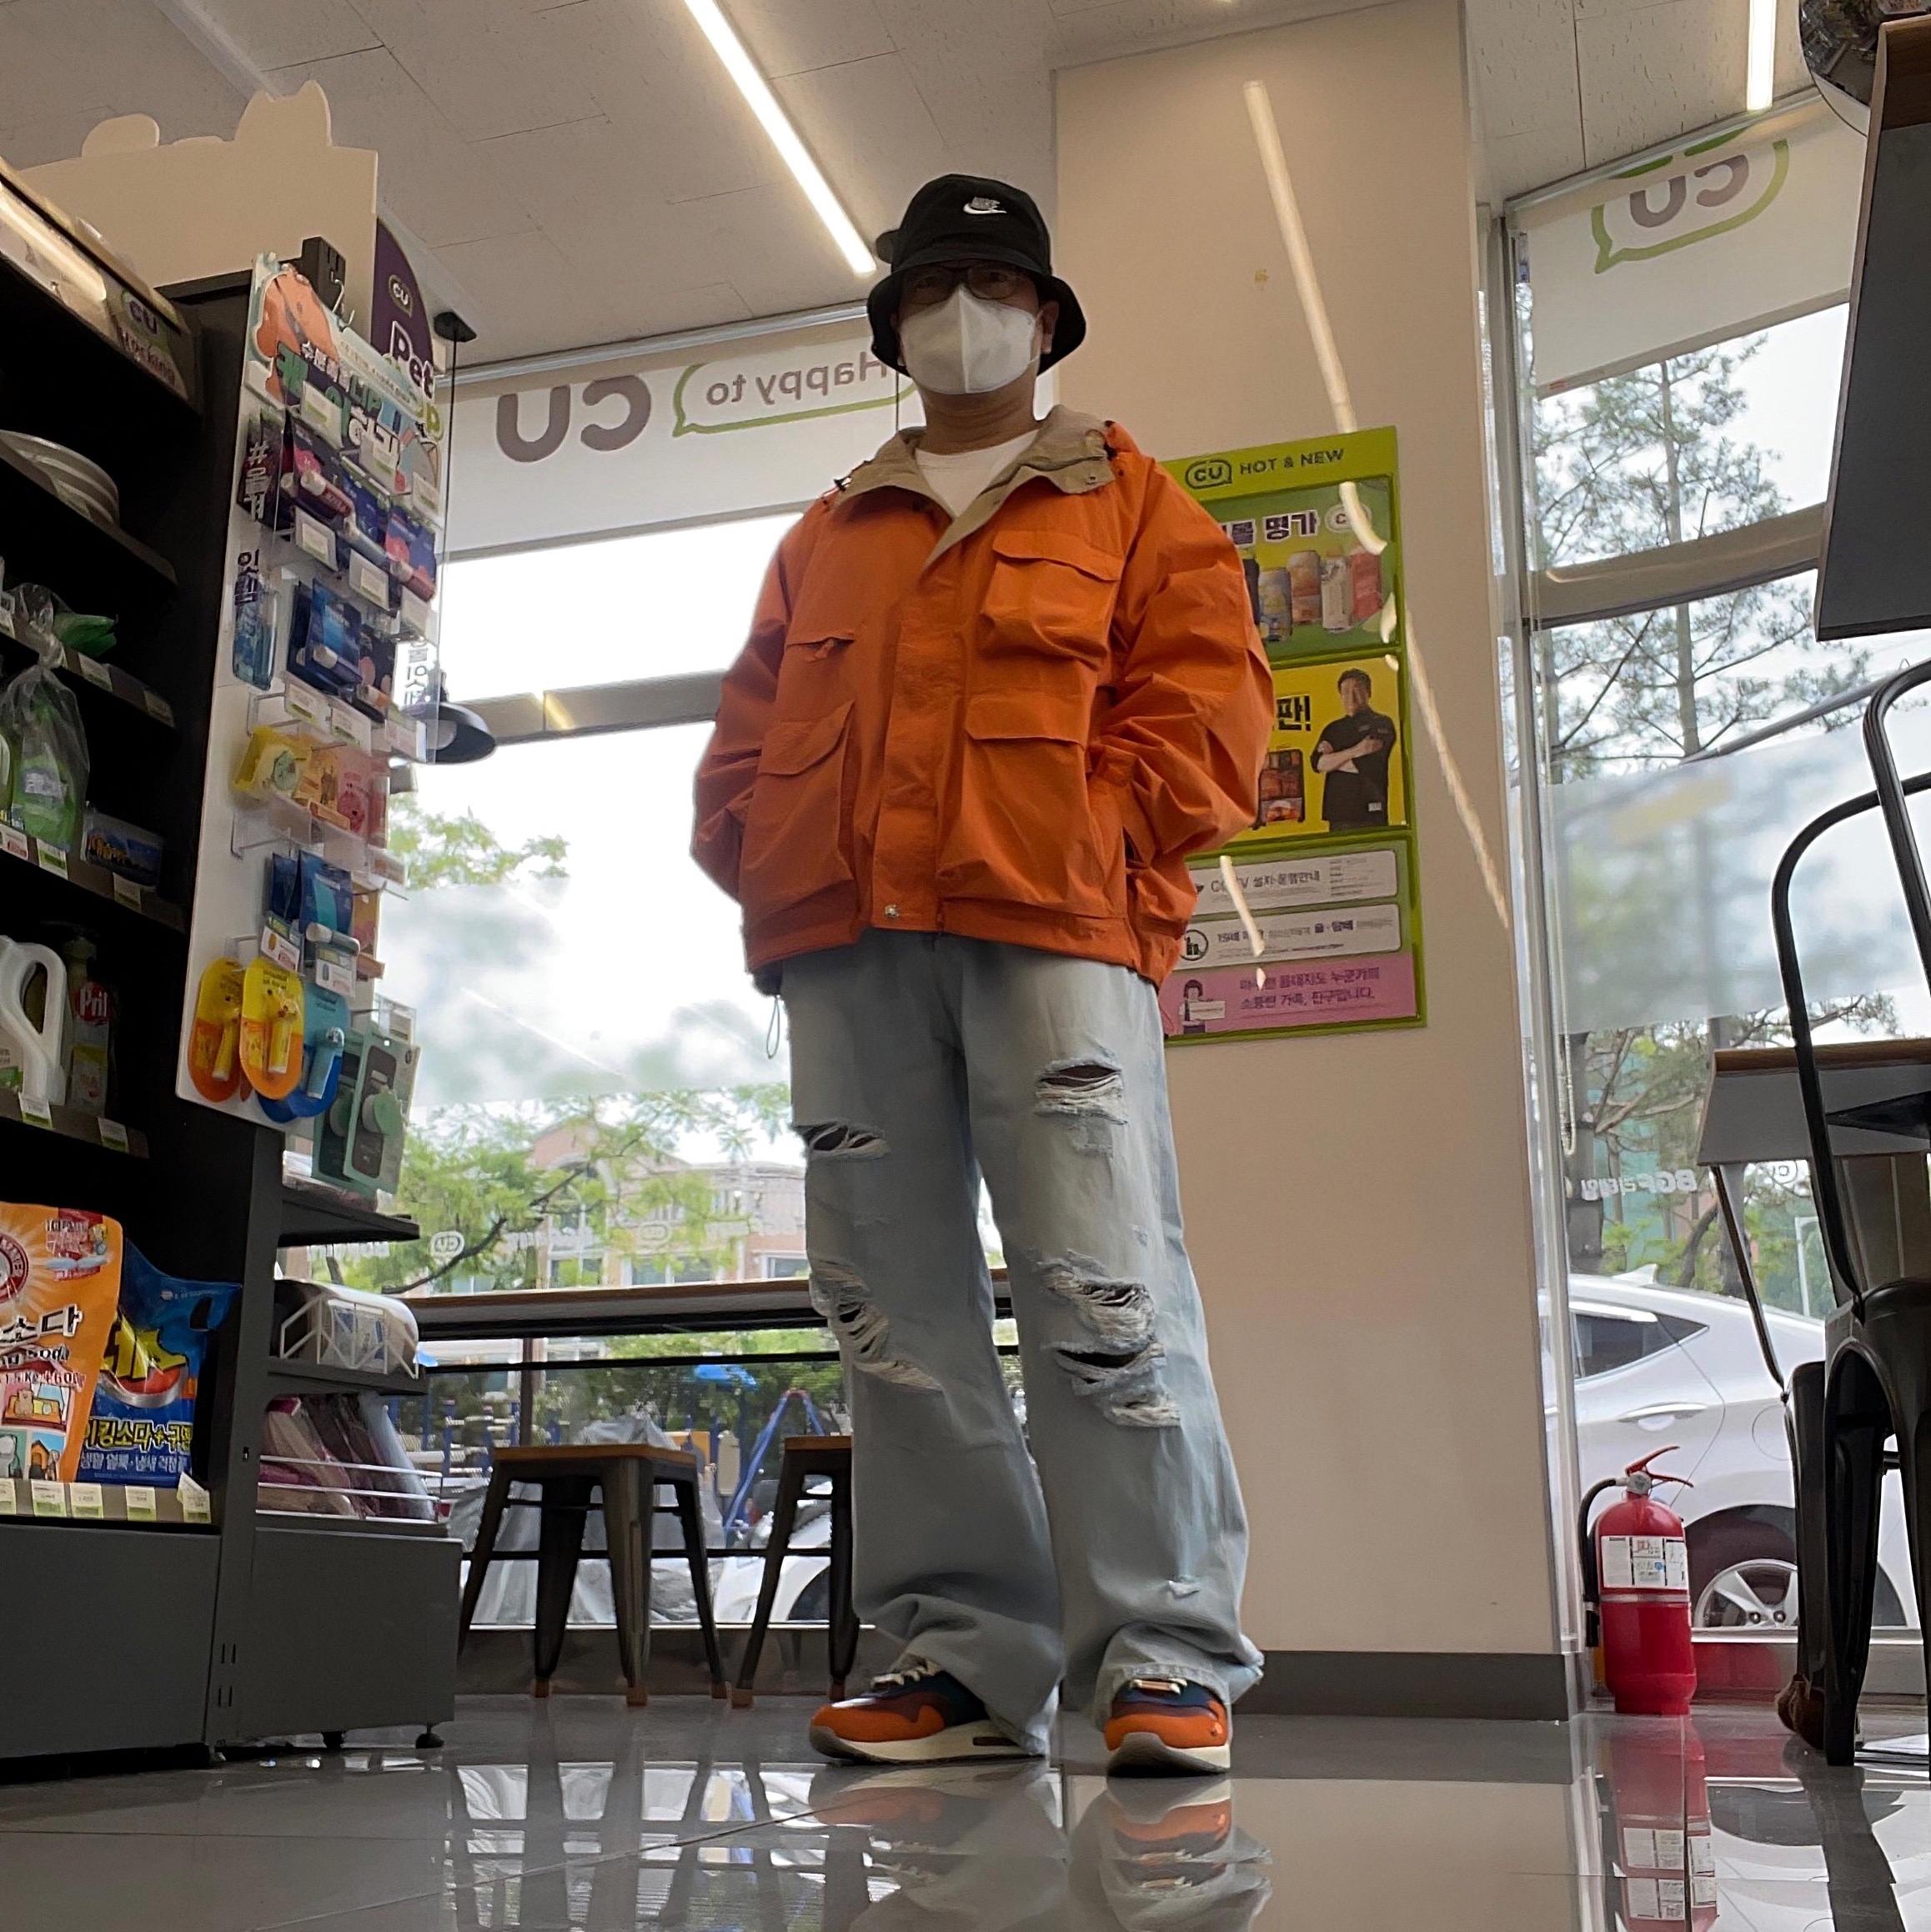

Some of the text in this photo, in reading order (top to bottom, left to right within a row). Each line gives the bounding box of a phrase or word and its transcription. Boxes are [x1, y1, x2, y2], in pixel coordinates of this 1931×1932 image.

[393, 282, 409, 306] CU
[389, 320, 435, 404] Pet
[1193, 448, 1345, 482] CU HOT & NEW
